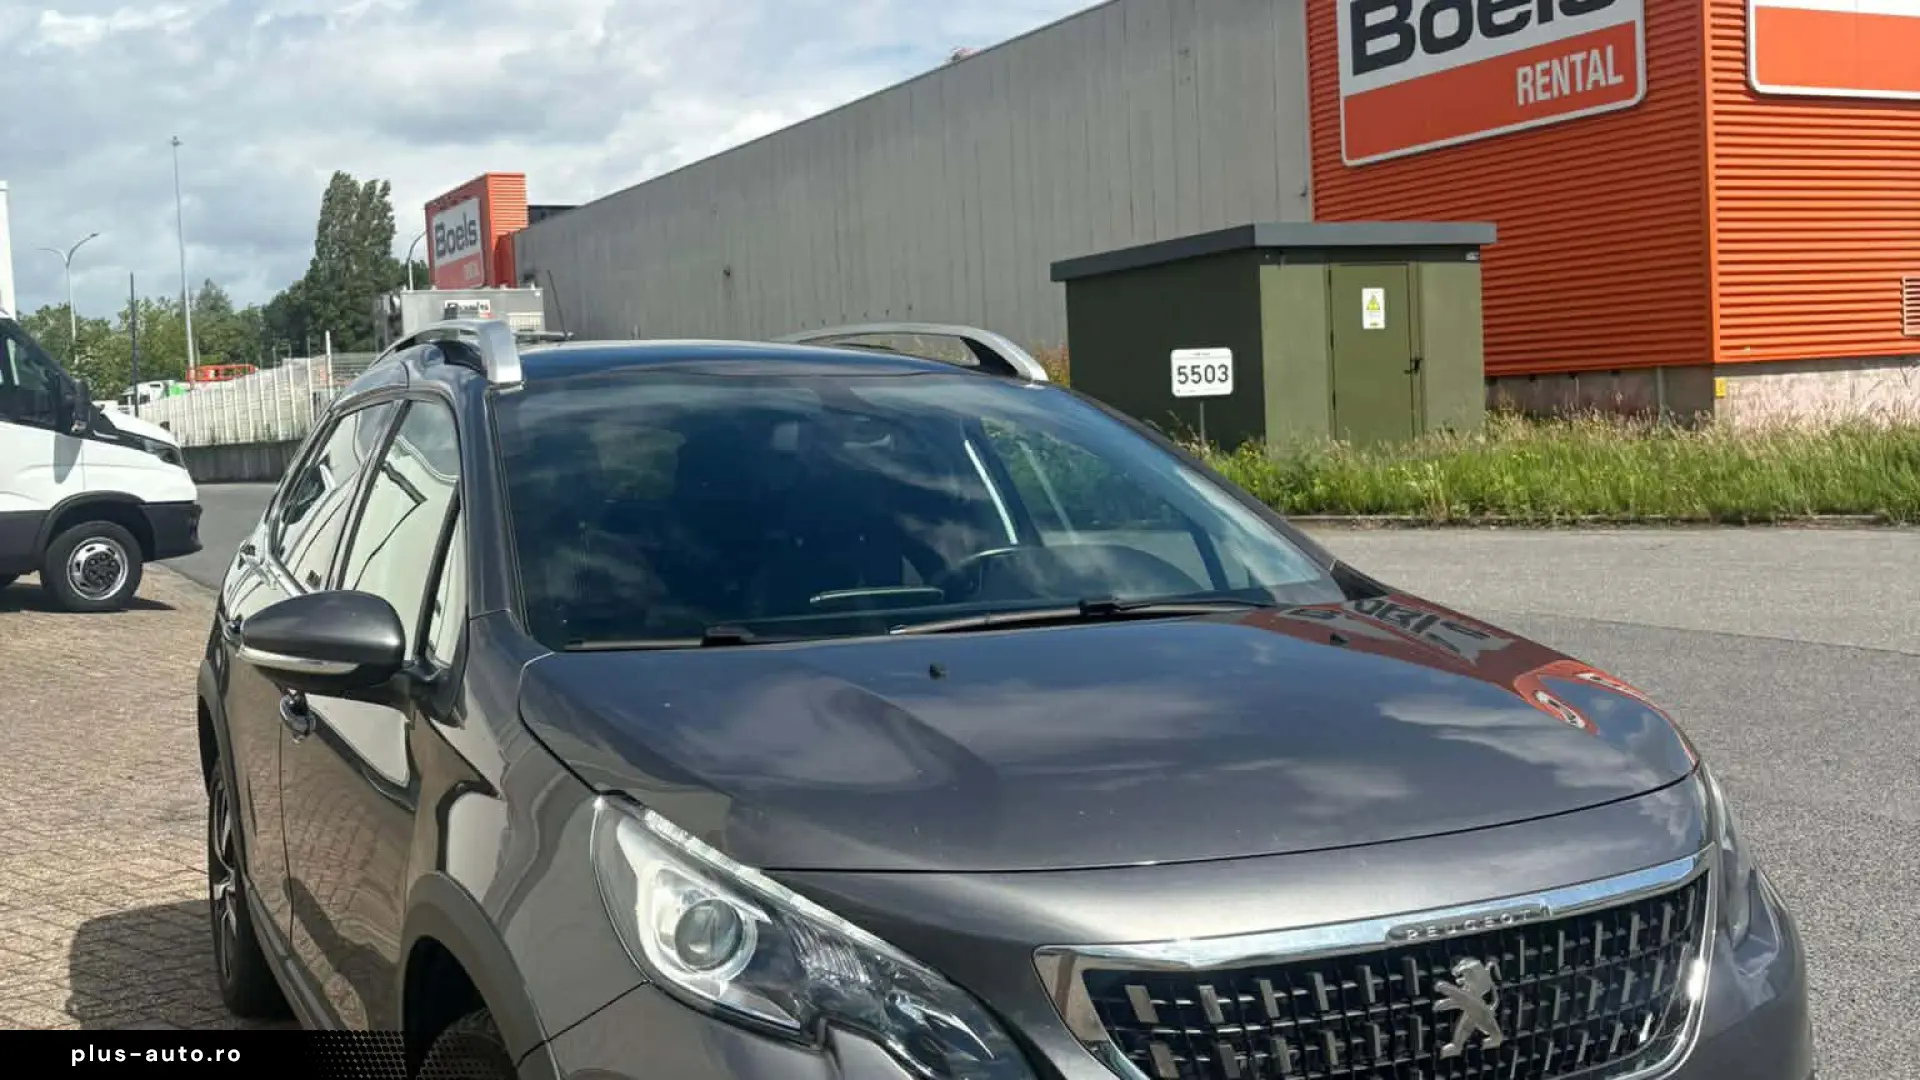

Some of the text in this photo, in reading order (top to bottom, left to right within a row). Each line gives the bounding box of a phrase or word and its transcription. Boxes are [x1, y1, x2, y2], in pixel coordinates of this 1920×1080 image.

[1351, 0, 1616, 76] Boe
[1516, 44, 1624, 106] RENTAL
[435, 211, 478, 257] Boels
[1177, 364, 1229, 385] 5503
[1406, 909, 1531, 941] PEUGEOT
